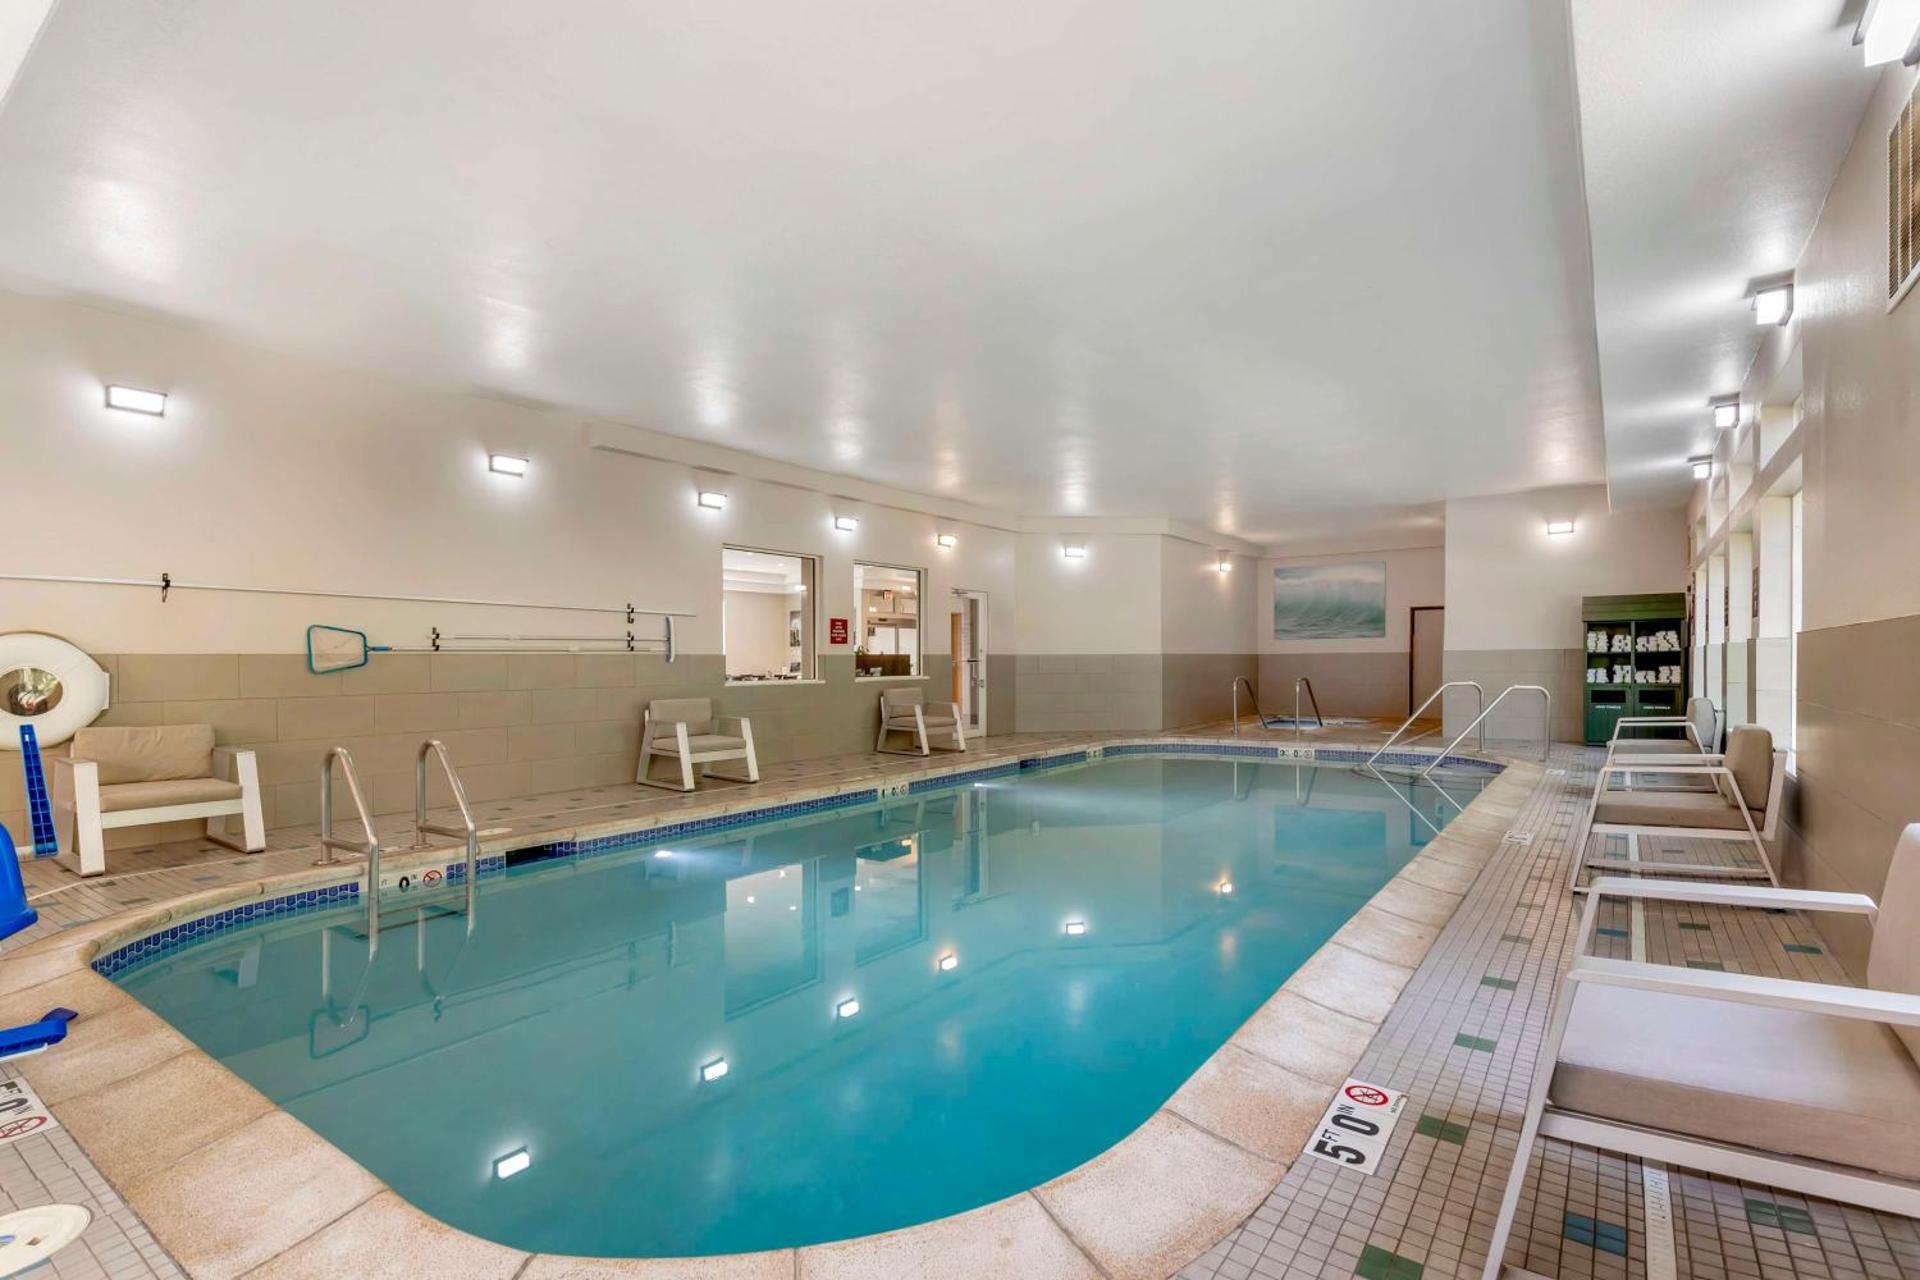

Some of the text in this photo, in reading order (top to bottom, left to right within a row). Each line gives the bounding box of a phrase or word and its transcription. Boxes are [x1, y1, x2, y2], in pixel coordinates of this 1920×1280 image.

[399, 876, 410, 890] 0
[1313, 1104, 1380, 1165] 5 FT 0 IN
